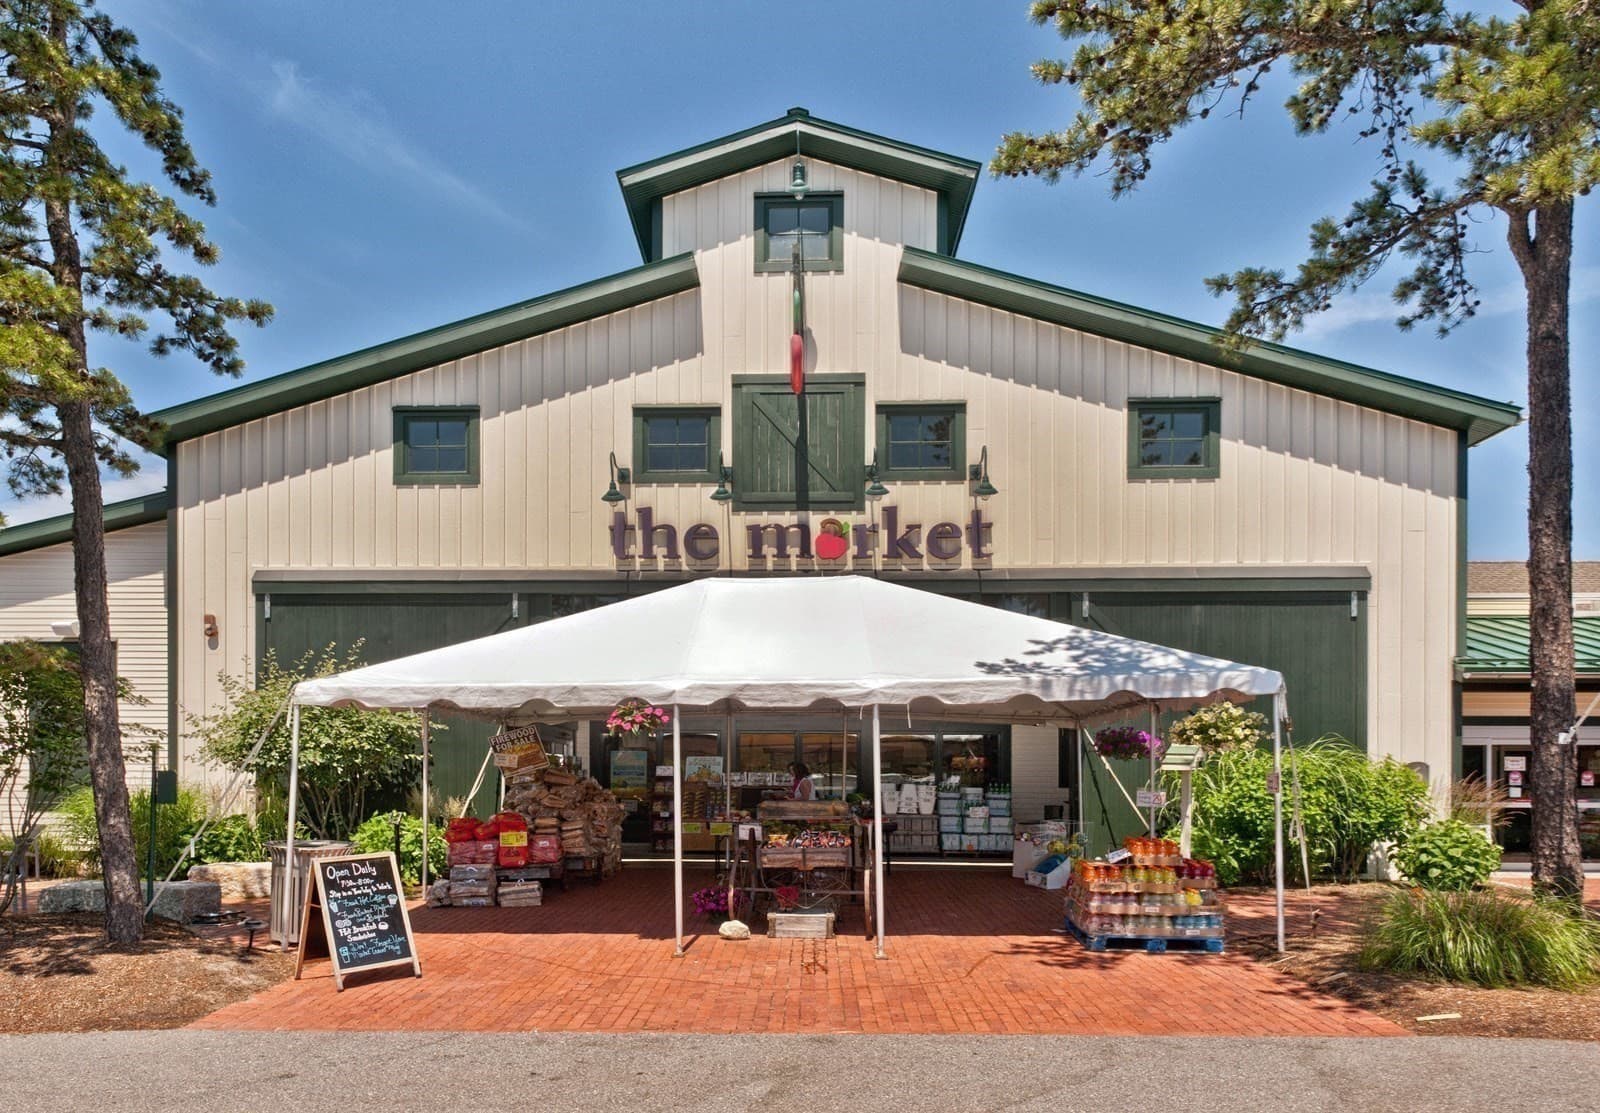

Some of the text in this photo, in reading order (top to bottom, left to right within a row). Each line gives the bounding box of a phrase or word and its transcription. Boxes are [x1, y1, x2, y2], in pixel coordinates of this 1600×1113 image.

[609, 506, 993, 560] the market
[490, 727, 535, 746] FIREWOOD
[495, 735, 536, 752] FOR SALE
[327, 861, 376, 883] Open Daily
